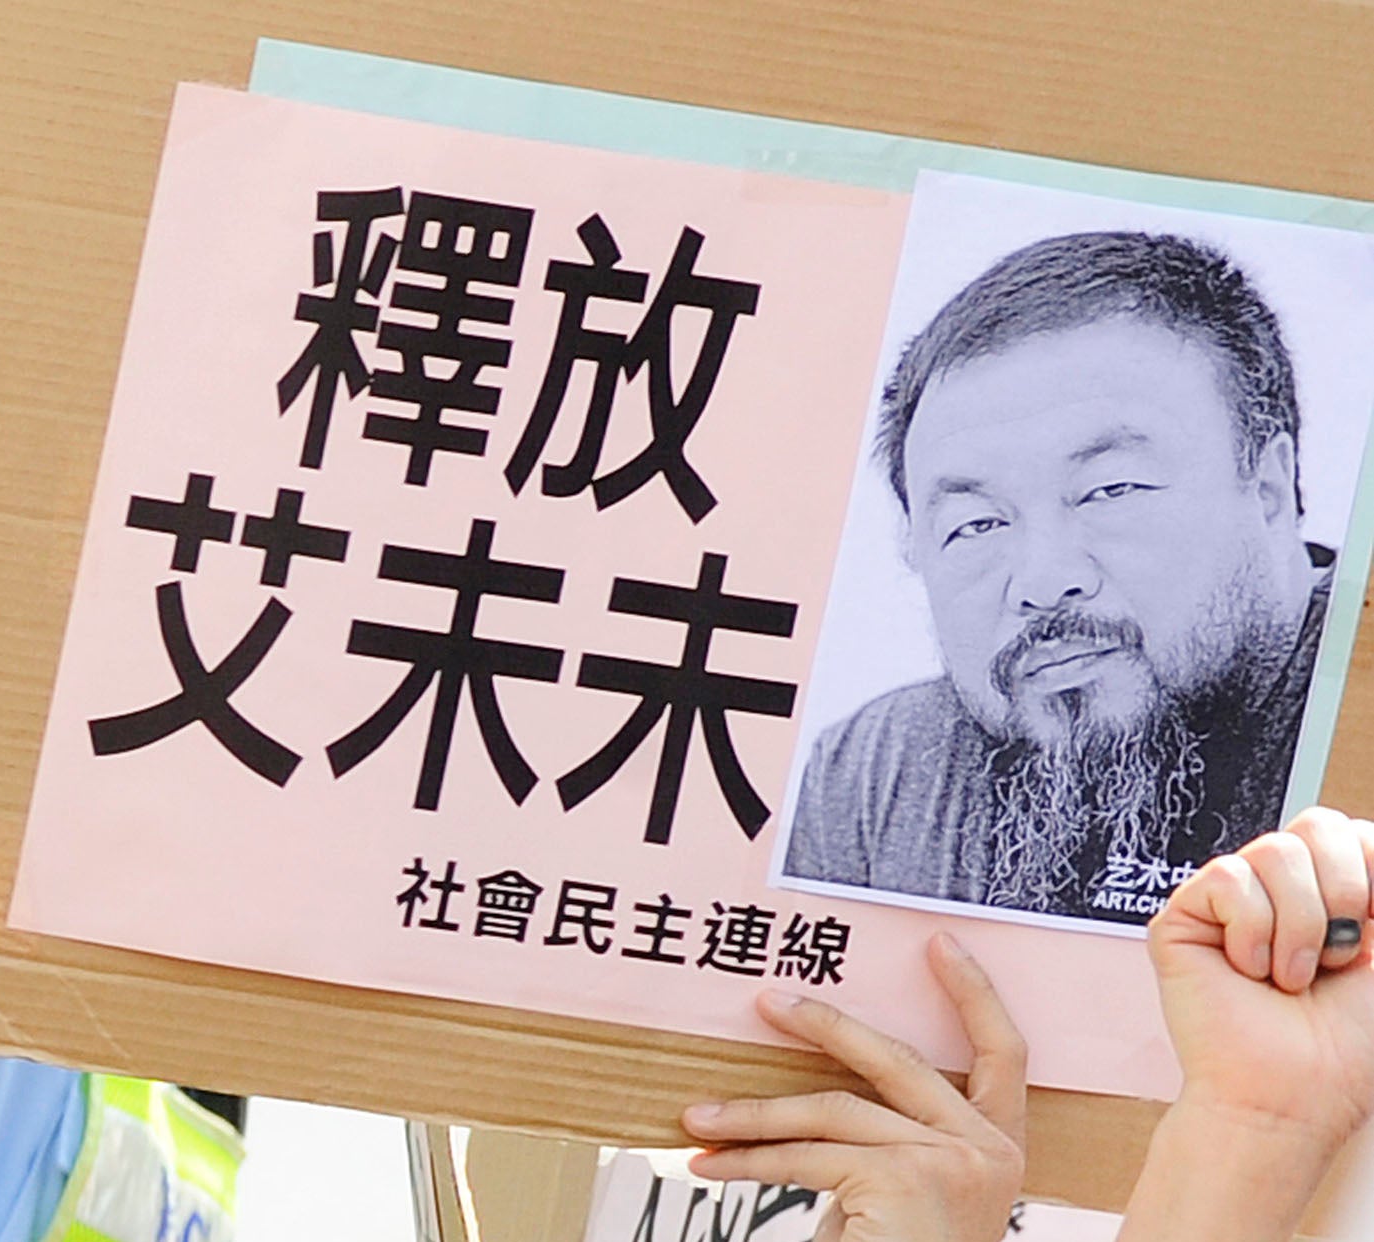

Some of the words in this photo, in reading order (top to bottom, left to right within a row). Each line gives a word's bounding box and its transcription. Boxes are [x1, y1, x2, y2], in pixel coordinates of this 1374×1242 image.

[276, 186, 761, 526] 釋放
[87, 472, 799, 846] 艾未未
[395, 857, 852, 986] 社會民主連線
